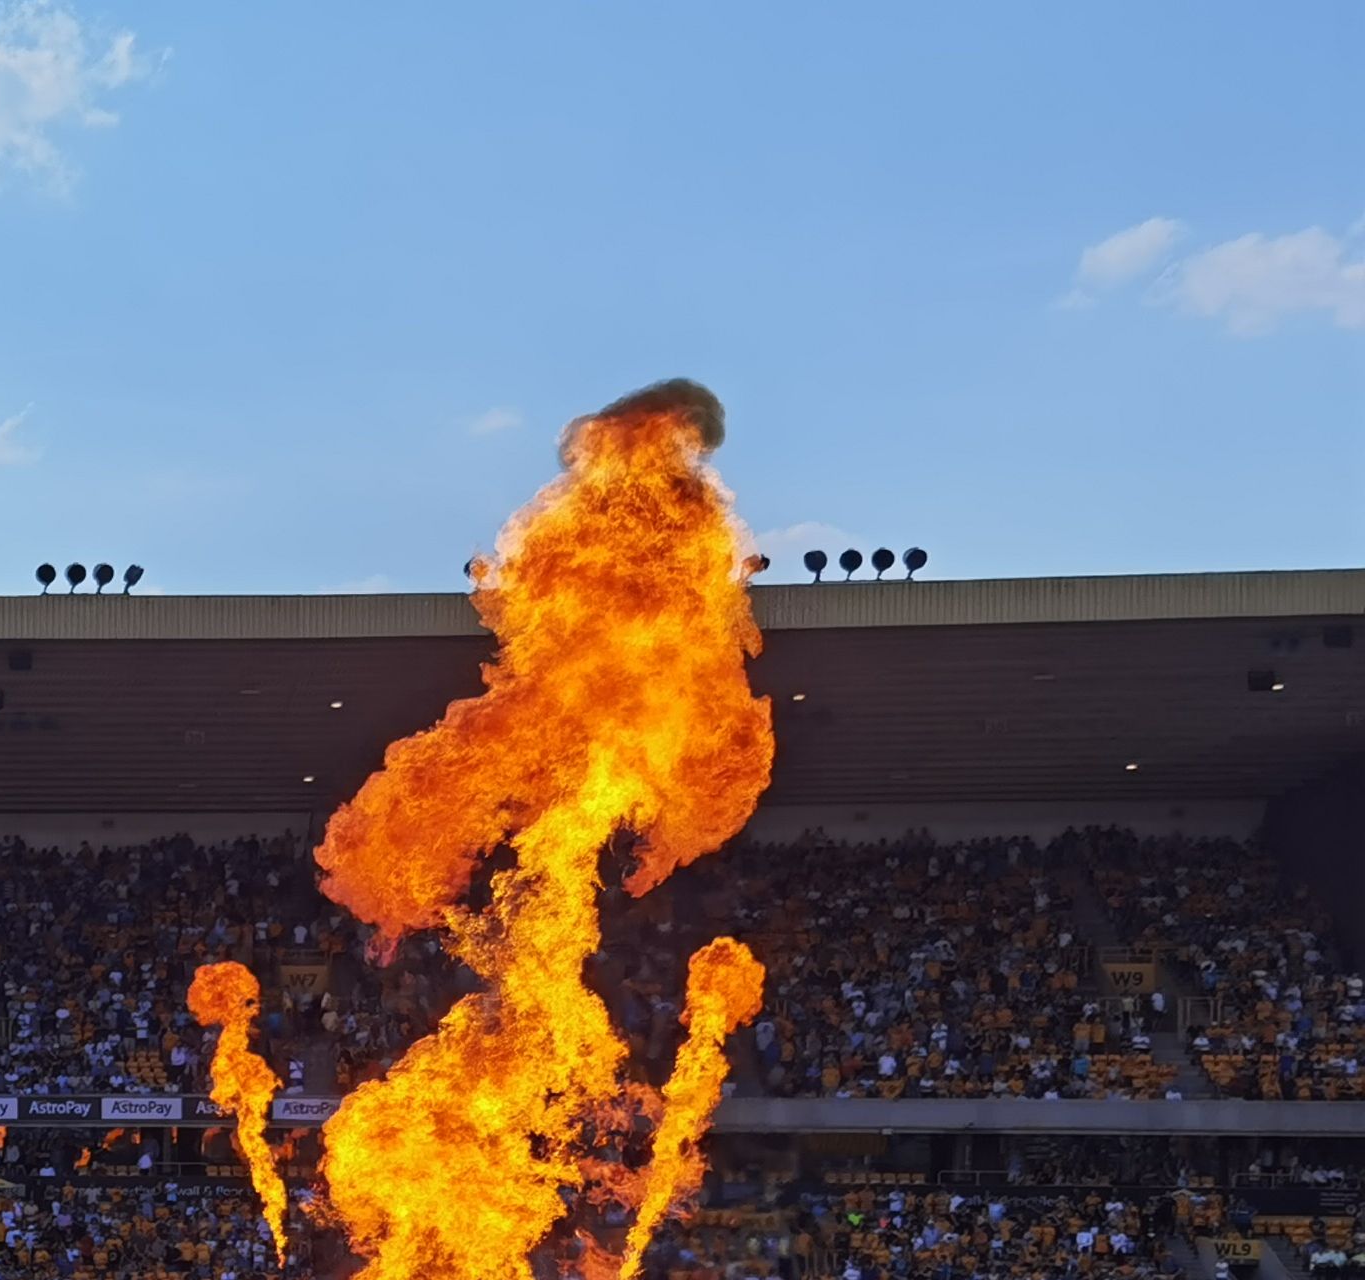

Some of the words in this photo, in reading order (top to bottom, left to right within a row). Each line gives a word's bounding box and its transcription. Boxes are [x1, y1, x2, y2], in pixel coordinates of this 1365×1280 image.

[1110, 972, 1143, 987] W9
[29, 1100, 91, 1116] AstroPay
[111, 1100, 172, 1116] AstroPay
[282, 1102, 335, 1115] AstroP
[1214, 1243, 1251, 1256] WL9
